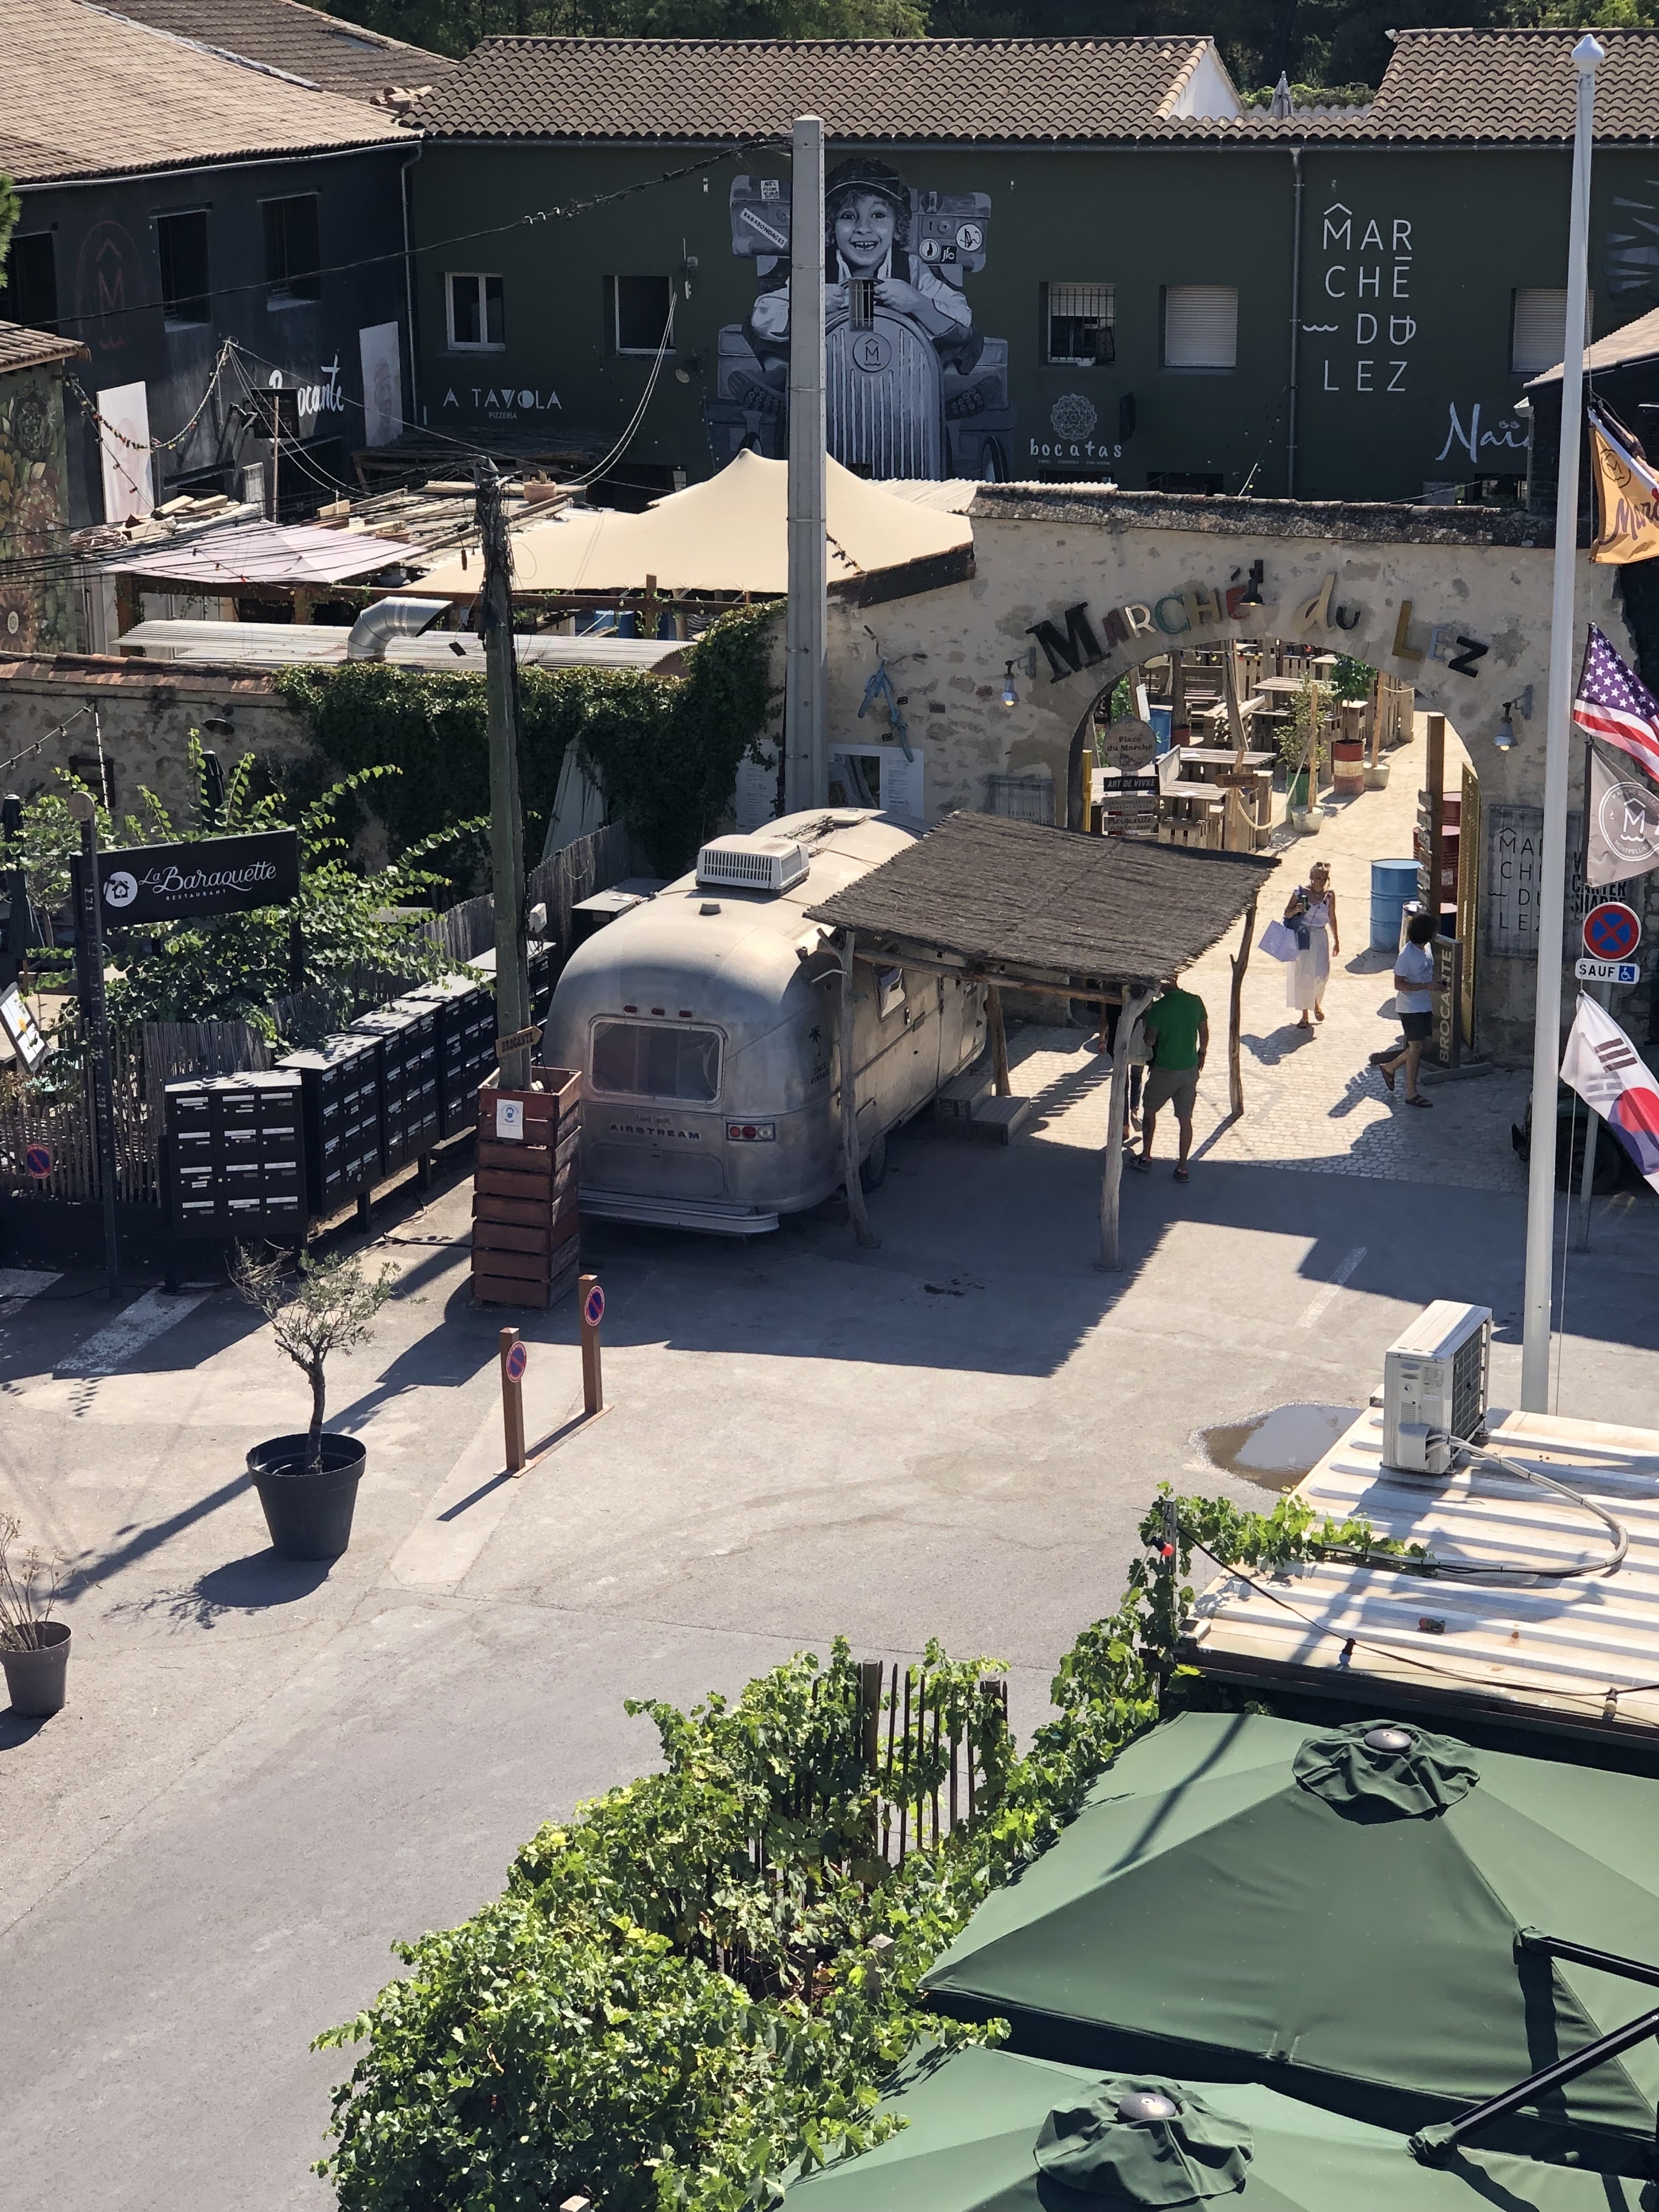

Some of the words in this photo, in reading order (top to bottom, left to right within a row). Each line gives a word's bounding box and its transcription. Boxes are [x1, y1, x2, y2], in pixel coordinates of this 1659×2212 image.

[743, 212, 785, 245] VAGABONDAGES
[1357, 313, 1417, 345] DU
[1324, 360, 1408, 392] LEZ
[443, 388, 460, 407] A
[471, 388, 562, 409] TAVOLA
[1030, 438, 1122, 458] bocatas
[1391, 600, 1489, 678] LEZ
[1107, 780, 1121, 788] ART
[1122, 779, 1132, 787] DE
[1134, 779, 1155, 787] VIVRE
[1499, 836, 1543, 856] MA
[138, 868, 161, 885] La
[152, 861, 276, 894] Baraquette
[1500, 861, 1542, 881] CH
[1579, 964, 1616, 978] SAUF
[610, 1124, 700, 1140] AIRSTREAM
